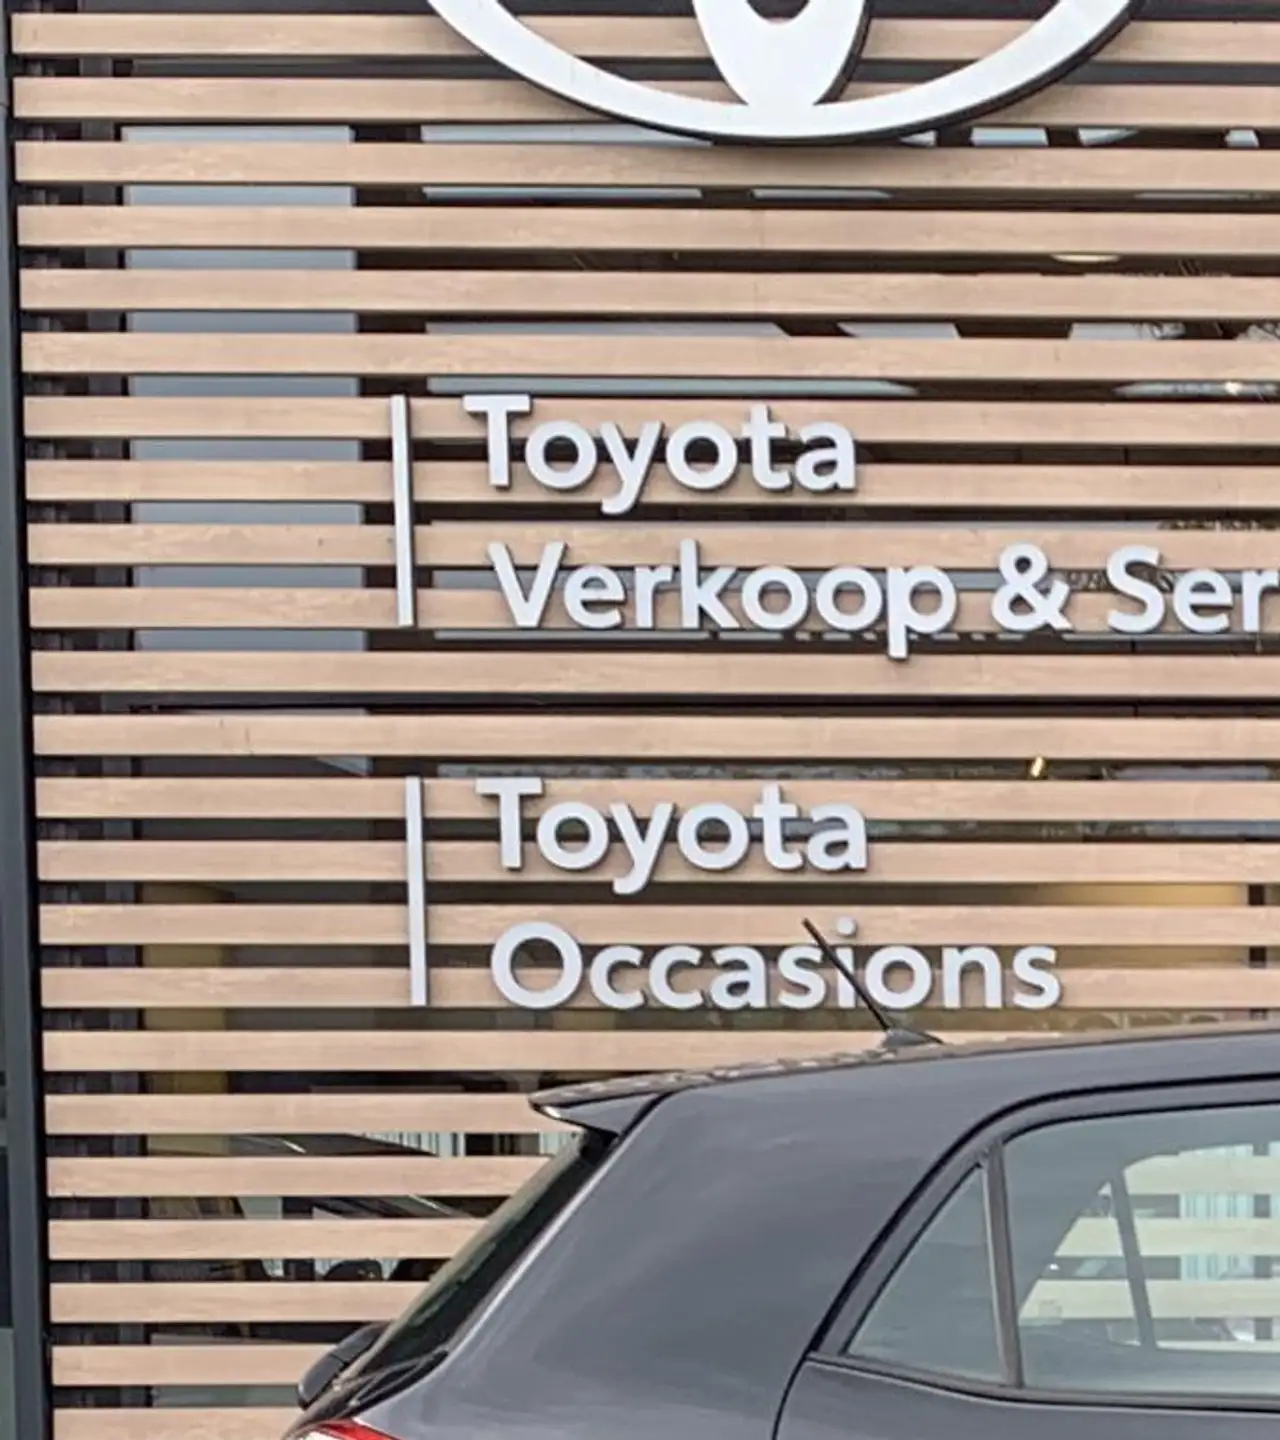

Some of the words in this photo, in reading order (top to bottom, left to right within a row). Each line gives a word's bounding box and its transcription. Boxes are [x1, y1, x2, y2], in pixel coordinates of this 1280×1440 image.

[462, 394, 858, 515] Toyota
[488, 538, 958, 660] Verkoop
[990, 541, 1075, 633] &
[474, 776, 869, 894] Toyota
[490, 915, 1062, 1010] Occasions
